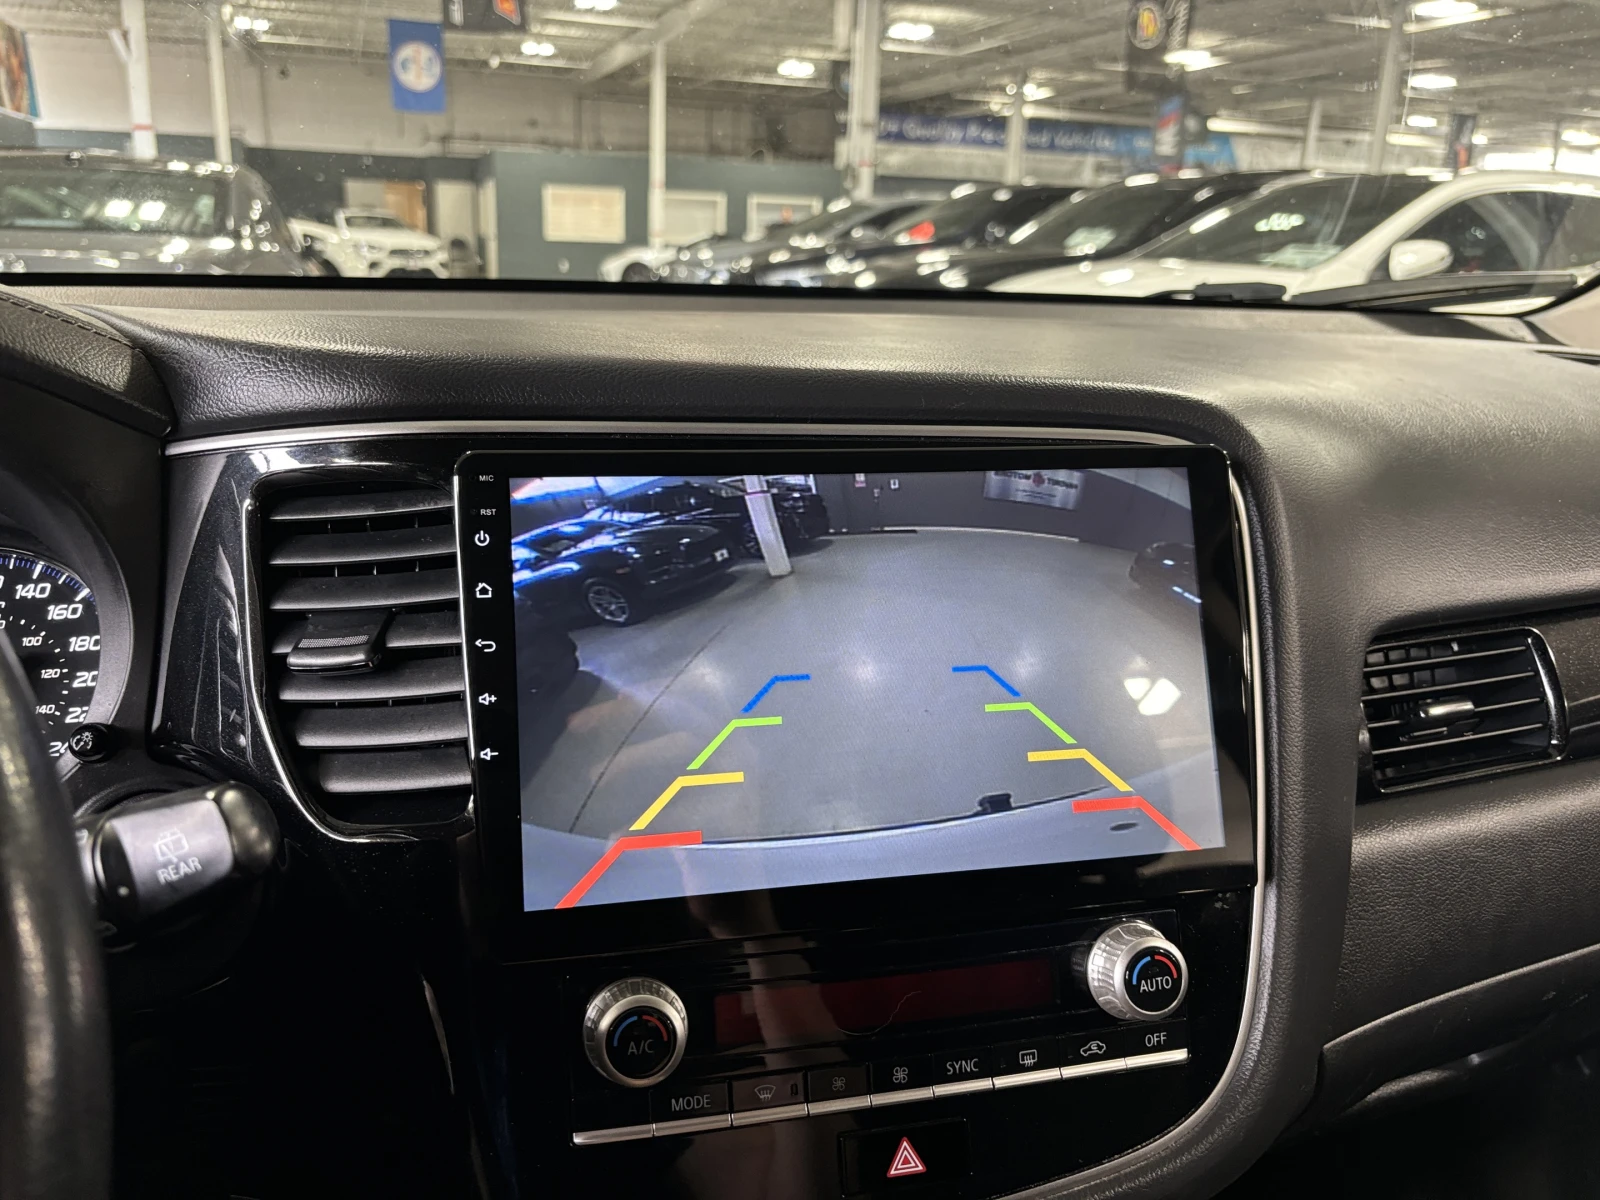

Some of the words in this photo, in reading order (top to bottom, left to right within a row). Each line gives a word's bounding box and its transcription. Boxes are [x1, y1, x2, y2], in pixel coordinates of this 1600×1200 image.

[15, 582, 52, 600] 140
[47, 603, 83, 621] 160
[22, 636, 43, 647] 100
[69, 635, 100, 652] 180
[41, 669, 61, 679] 120
[72, 671, 99, 688] 20
[35, 704, 56, 715] 140
[155, 856, 203, 886] REAR
[1140, 975, 1172, 993] AUTO
[627, 1039, 655, 1056] A/C
[1145, 1032, 1167, 1047] OFF
[946, 1058, 979, 1075] SYNC
[671, 1094, 712, 1112] MODE
